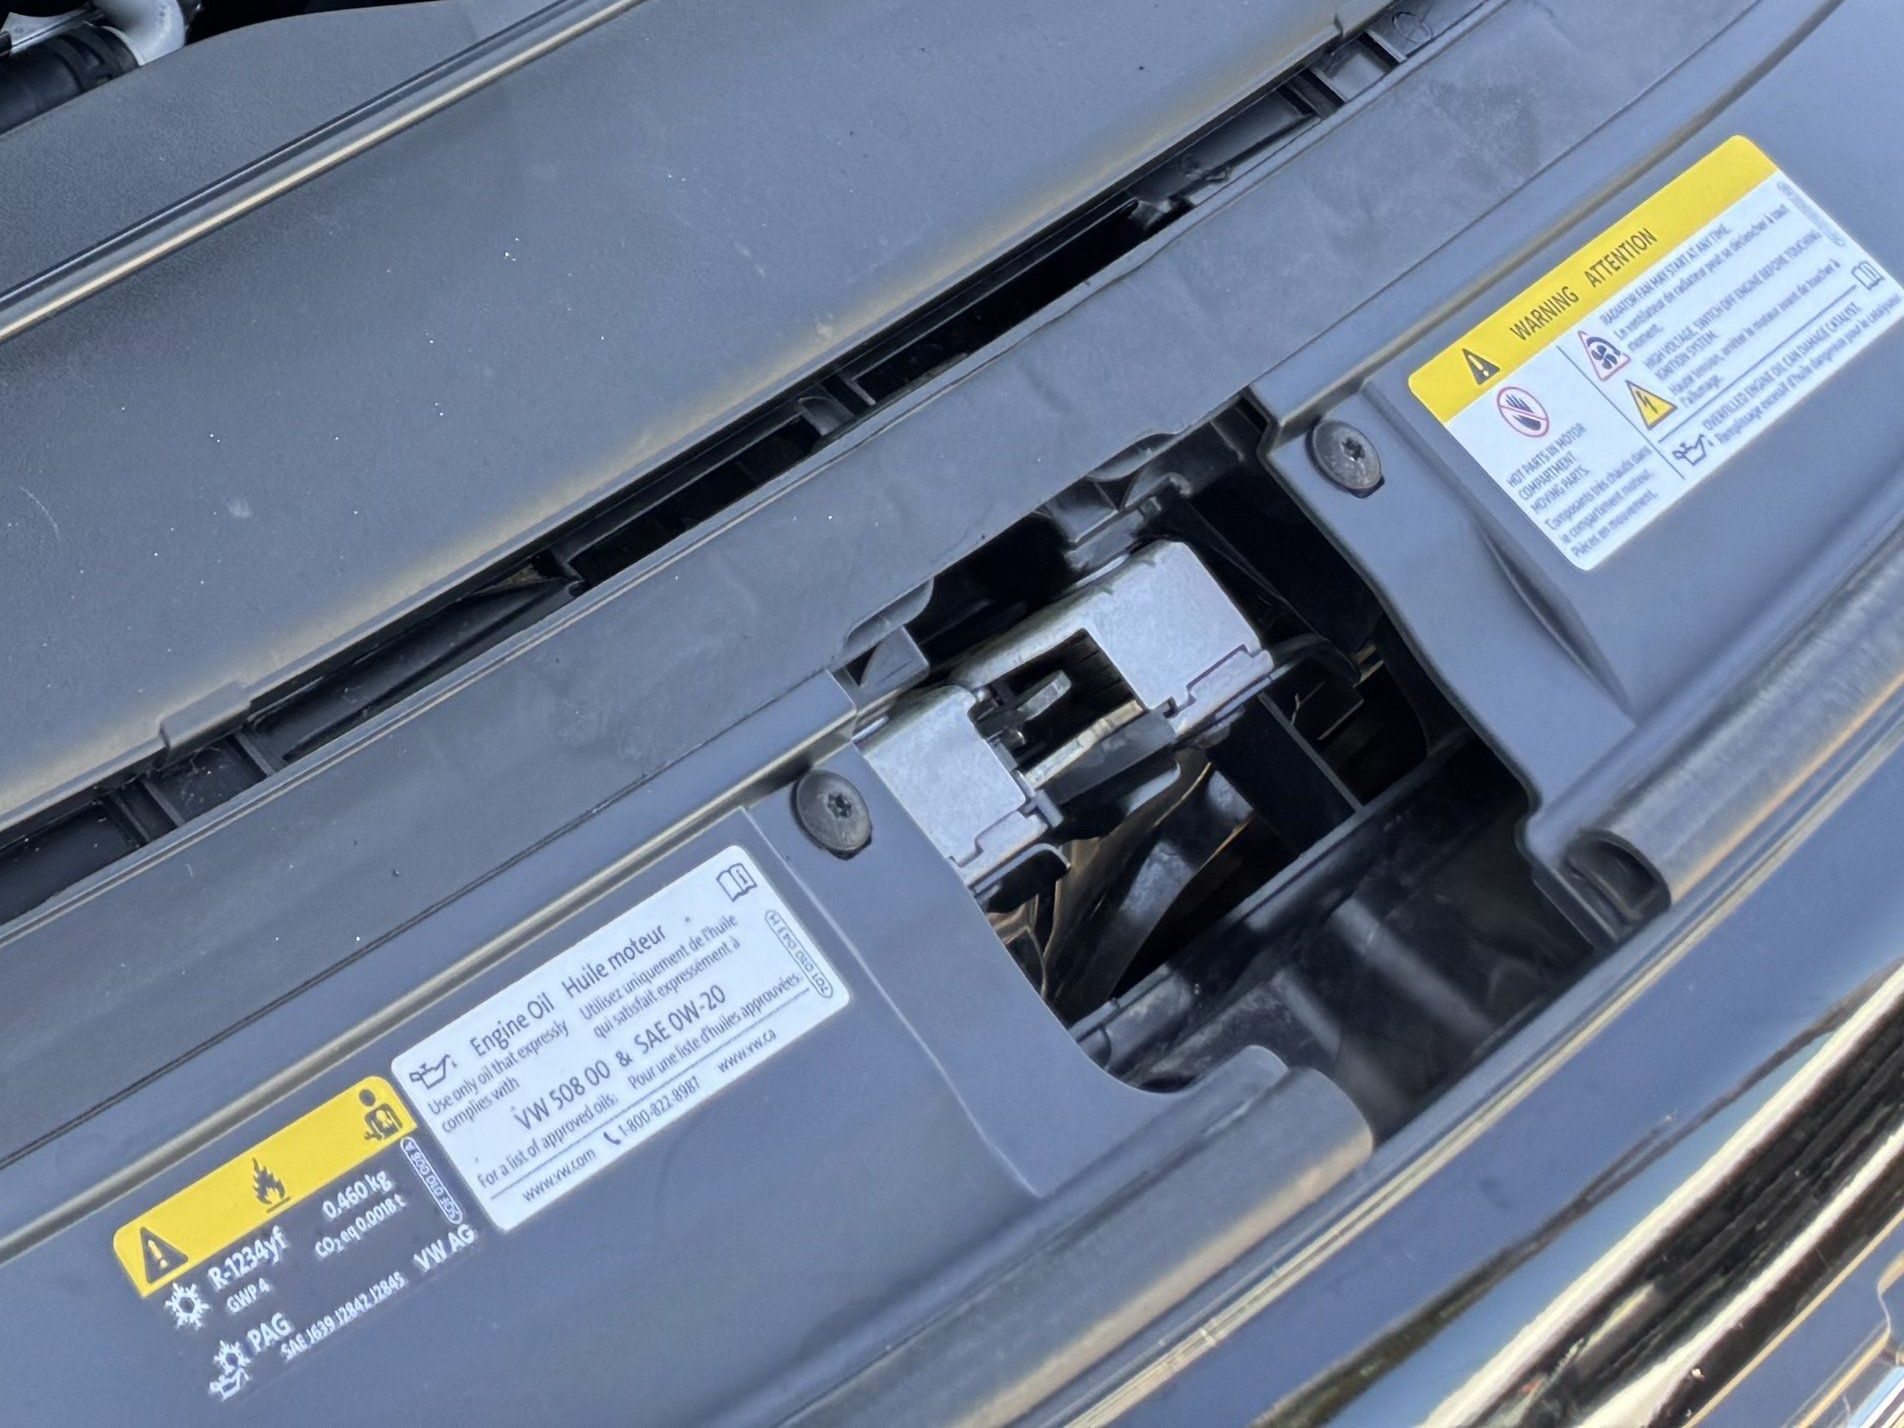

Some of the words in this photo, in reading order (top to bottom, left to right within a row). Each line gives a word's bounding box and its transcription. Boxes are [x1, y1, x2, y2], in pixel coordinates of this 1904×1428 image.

[1508, 285, 1579, 340] WARNING
[1584, 227, 1657, 287] ATTENTION
[1599, 293, 1639, 325] RADIATOR
[1634, 281, 1655, 299] FAN
[1648, 269, 1668, 288] MAY
[1664, 253, 1689, 276] START
[1685, 246, 1698, 261] AT
[1695, 235, 1712, 253] ANY
[1506, 468, 1525, 488] HOT
[1521, 450, 1550, 475] PARTS
[1545, 443, 1559, 456] IN
[1554, 422, 1586, 449] MOTOR
[1518, 451, 1576, 500] COMPARTMENT
[1530, 483, 1565, 513] MOVING
[469, 1013, 529, 1057] Engine
[526, 991, 554, 1019] Oil
[560, 962, 609, 998] Huile
[607, 925, 665, 970] moteur
[578, 988, 623, 1020] Utilisez
[622, 944, 689, 994] uniquement
[688, 935, 705, 952] de
[700, 915, 737, 941] l'huile
[592, 1019, 614, 1038] qui
[612, 989, 658, 1025] satisfait
[656, 941, 731, 997] expressément
[427, 1094, 453, 1115] Use
[451, 1078, 479, 1101] only
[476, 1065, 494, 1085] oil
[490, 1051, 519, 1074] that
[516, 1020, 569, 1059] expressly
[513, 1096, 550, 1130] VW
[548, 1076, 585, 1109] 508
[583, 1059, 610, 1086] 00
[614, 1050, 633, 1067] &
[633, 1020, 670, 1054] SAE
[667, 984, 725, 1031] 0W-20
[627, 1066, 656, 1089] Pour
[656, 1052, 678, 1073] une
[674, 1037, 701, 1058] liste
[699, 1011, 741, 1044] d'huiles
[441, 1095, 492, 1133] complies
[490, 1077, 520, 1100] with
[476, 1169, 499, 1188] For
[505, 1149, 529, 1170] list
[541, 1104, 594, 1149] approved
[522, 1148, 595, 1201] www.vw.com
[618, 1075, 699, 1136] 1-800-822-8987
[717, 1028, 776, 1072] www.vw.ca
[208, 1226, 287, 1290] R-1234yf
[322, 1181, 368, 1218] 0.460
[364, 1170, 394, 1192] kg
[226, 1284, 257, 1313] GWP
[339, 1225, 360, 1242] eq
[355, 1198, 396, 1231] 0.0018
[247, 1312, 291, 1351] PAG
[280, 1333, 307, 1359] SAE
[306, 1315, 335, 1343] J639
[334, 1293, 372, 1325] J2842
[413, 1239, 447, 1270] VW
[447, 1223, 475, 1252] AG
